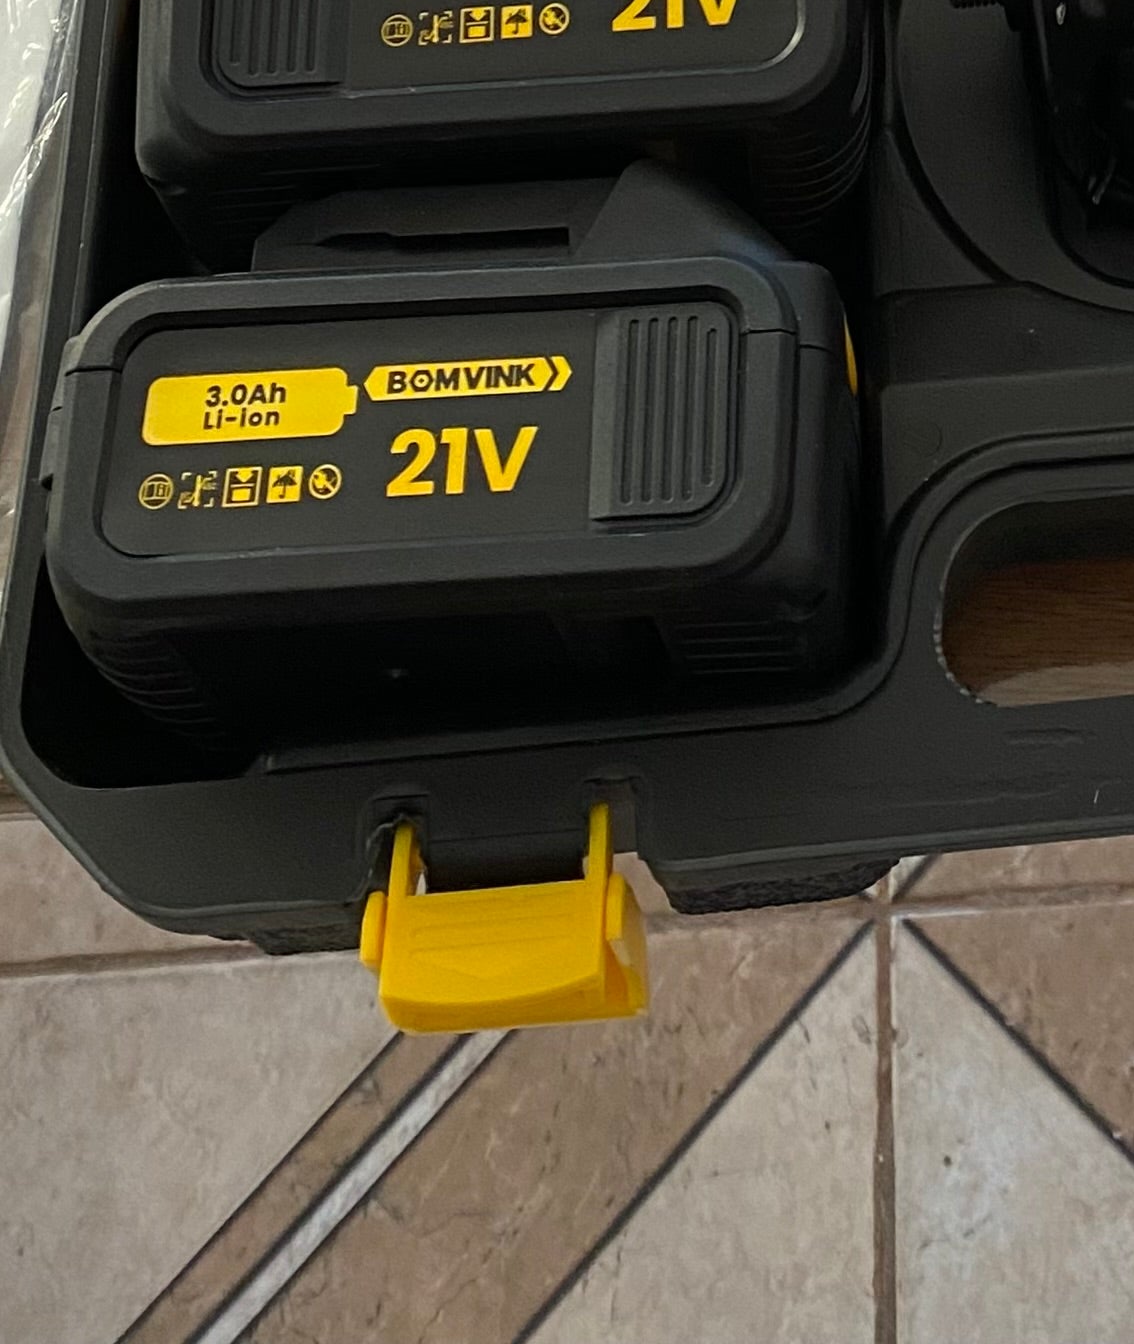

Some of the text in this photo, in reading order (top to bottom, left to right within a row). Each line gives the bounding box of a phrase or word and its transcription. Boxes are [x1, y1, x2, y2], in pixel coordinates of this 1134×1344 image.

[386, 362, 537, 395] BOMVINK
[204, 381, 287, 408] 3.0Ah
[202, 407, 280, 431] Li-ion
[386, 426, 538, 497] 21V
